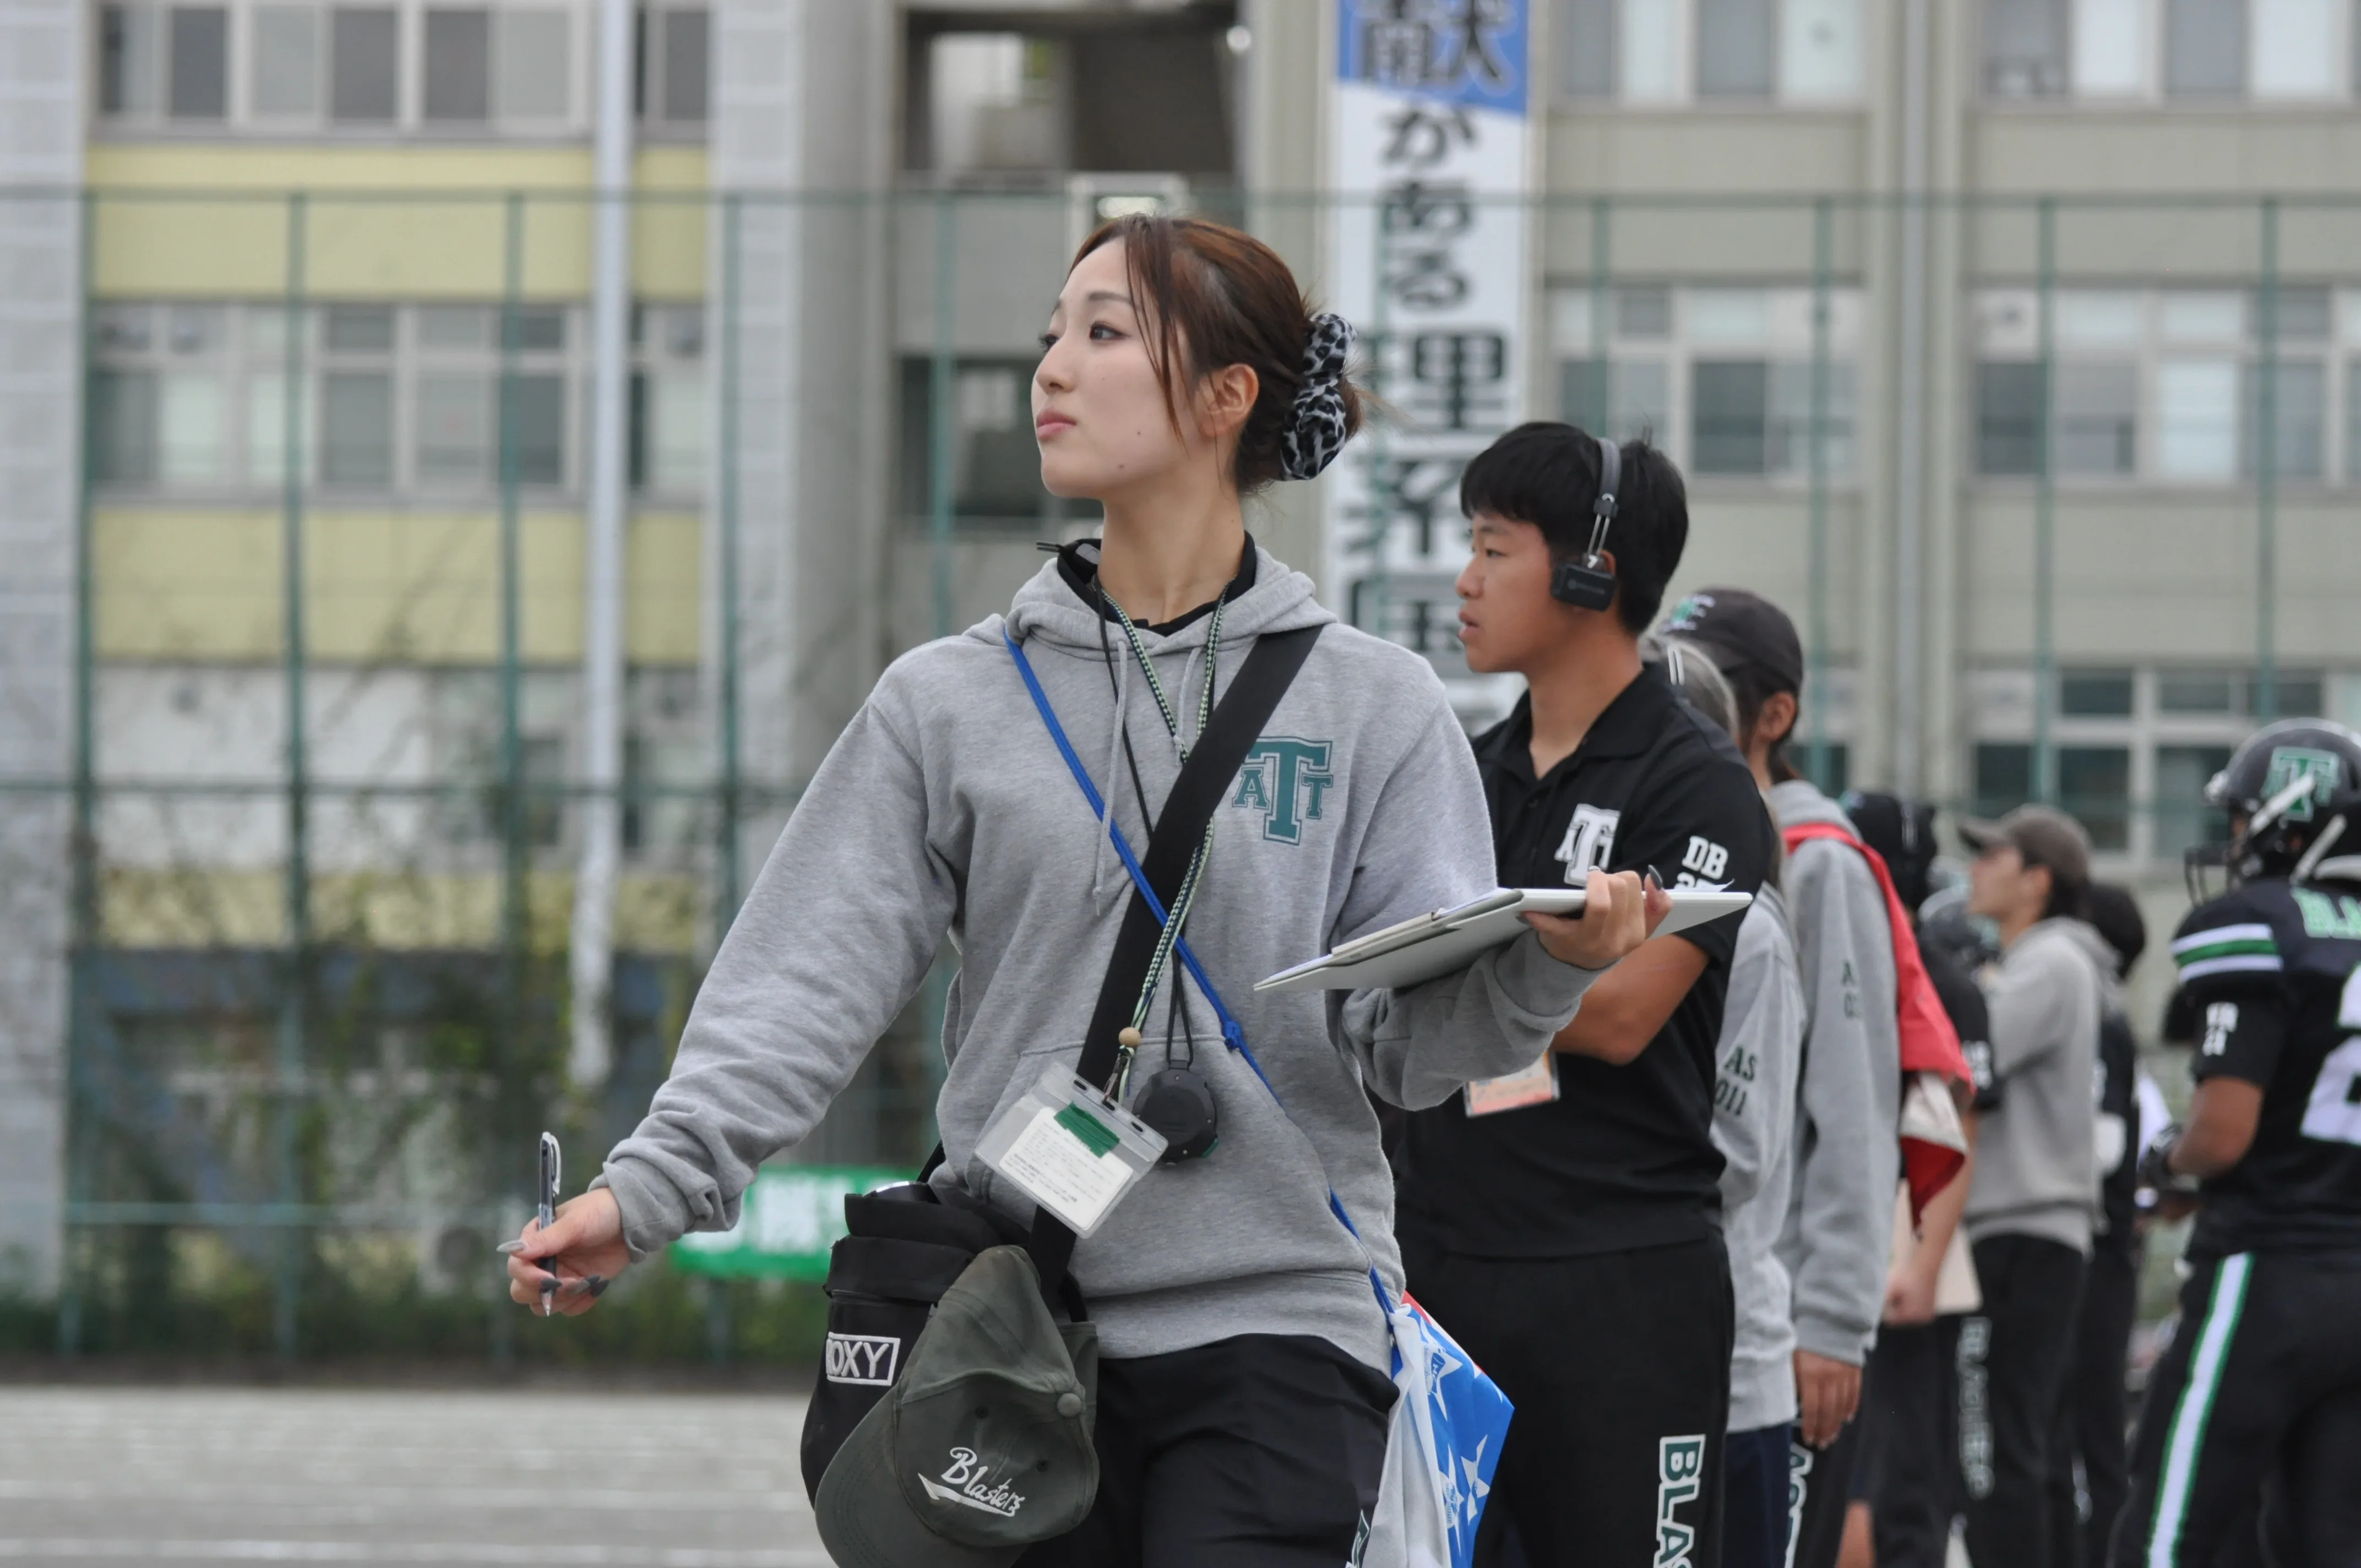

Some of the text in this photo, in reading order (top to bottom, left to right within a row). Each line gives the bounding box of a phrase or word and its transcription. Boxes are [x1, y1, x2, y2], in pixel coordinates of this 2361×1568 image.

[1682, 835, 1729, 880] DB
[1723, 1046, 1758, 1082] AS
[941, 1447, 1025, 1511] Blasters
[1653, 1434, 1706, 1568] BLA
